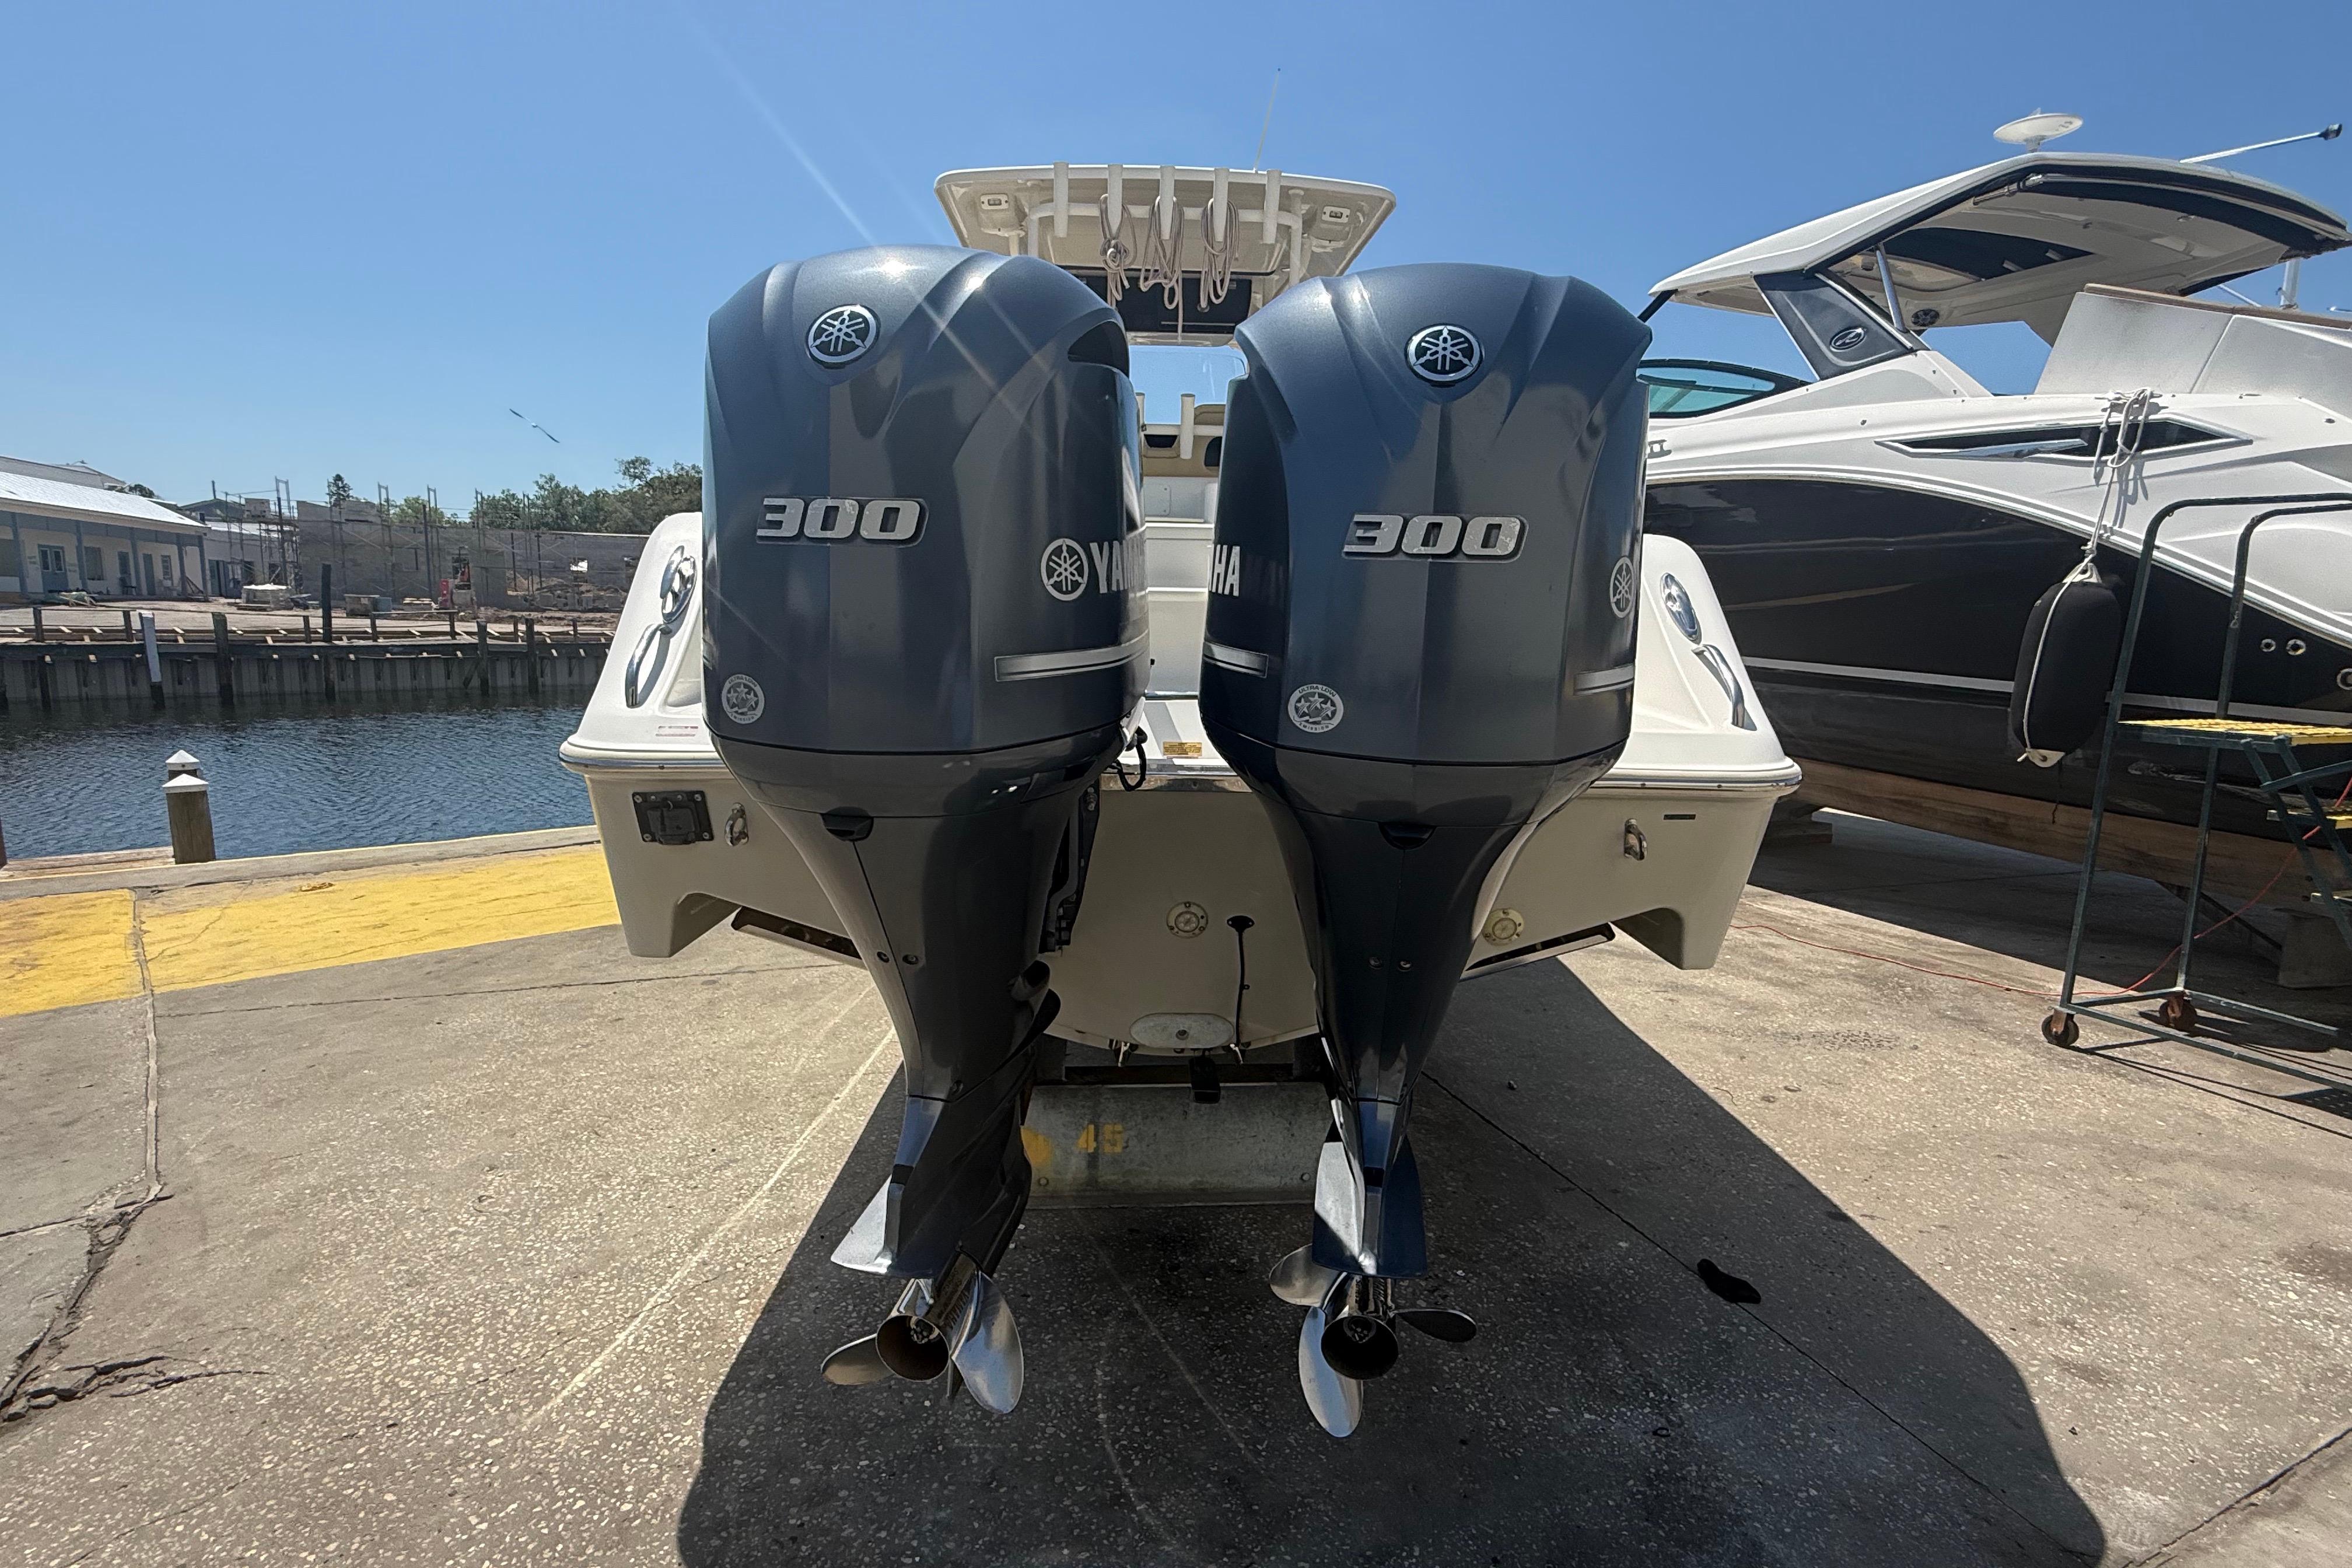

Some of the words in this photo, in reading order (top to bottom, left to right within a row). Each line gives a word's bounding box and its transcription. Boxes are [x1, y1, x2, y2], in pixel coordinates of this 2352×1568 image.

[757, 498, 921, 540] 300
[1343, 514, 1521, 555] 300
[1089, 540, 1144, 594] YAM
